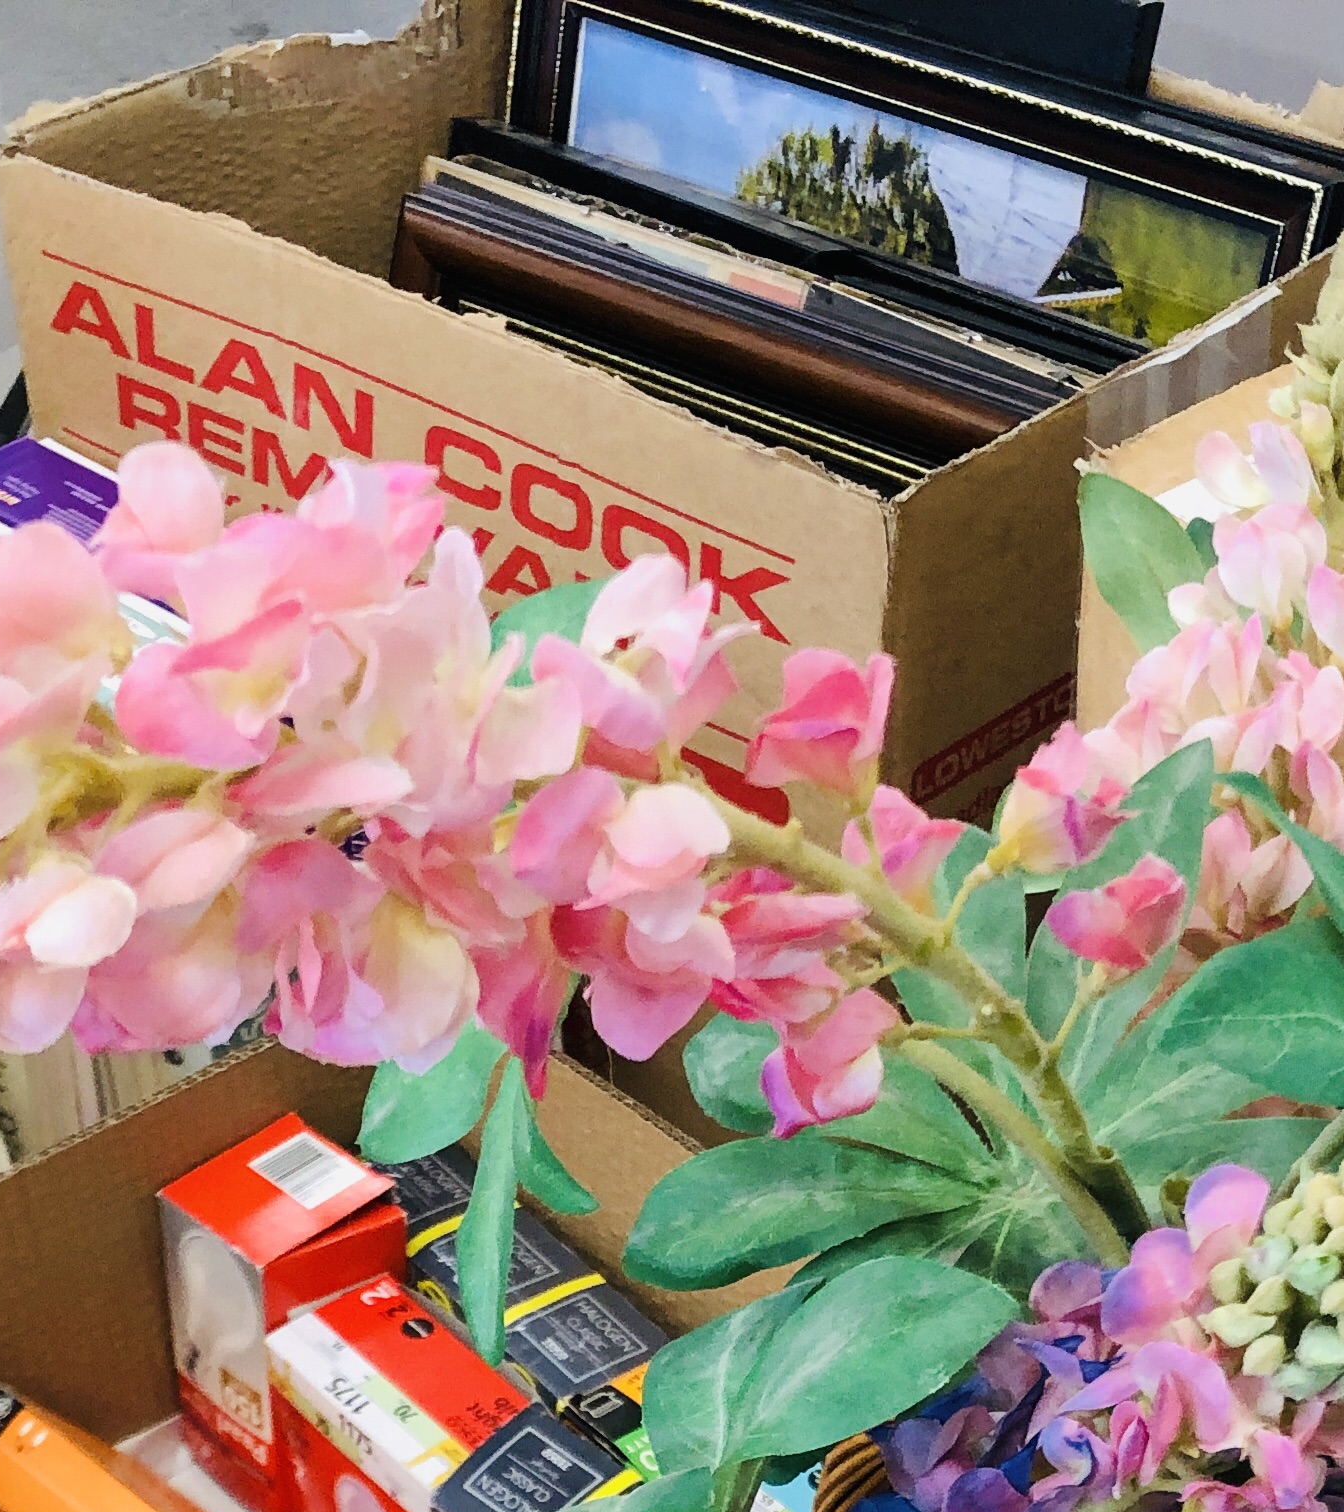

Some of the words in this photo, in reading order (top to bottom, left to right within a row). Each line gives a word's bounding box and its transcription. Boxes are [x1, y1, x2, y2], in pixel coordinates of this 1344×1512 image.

[50, 281, 374, 460] ALAN
[424, 424, 792, 647] COOK
[573, 1299, 638, 1354] HALOGEN
[324, 1376, 372, 1415] 1175
